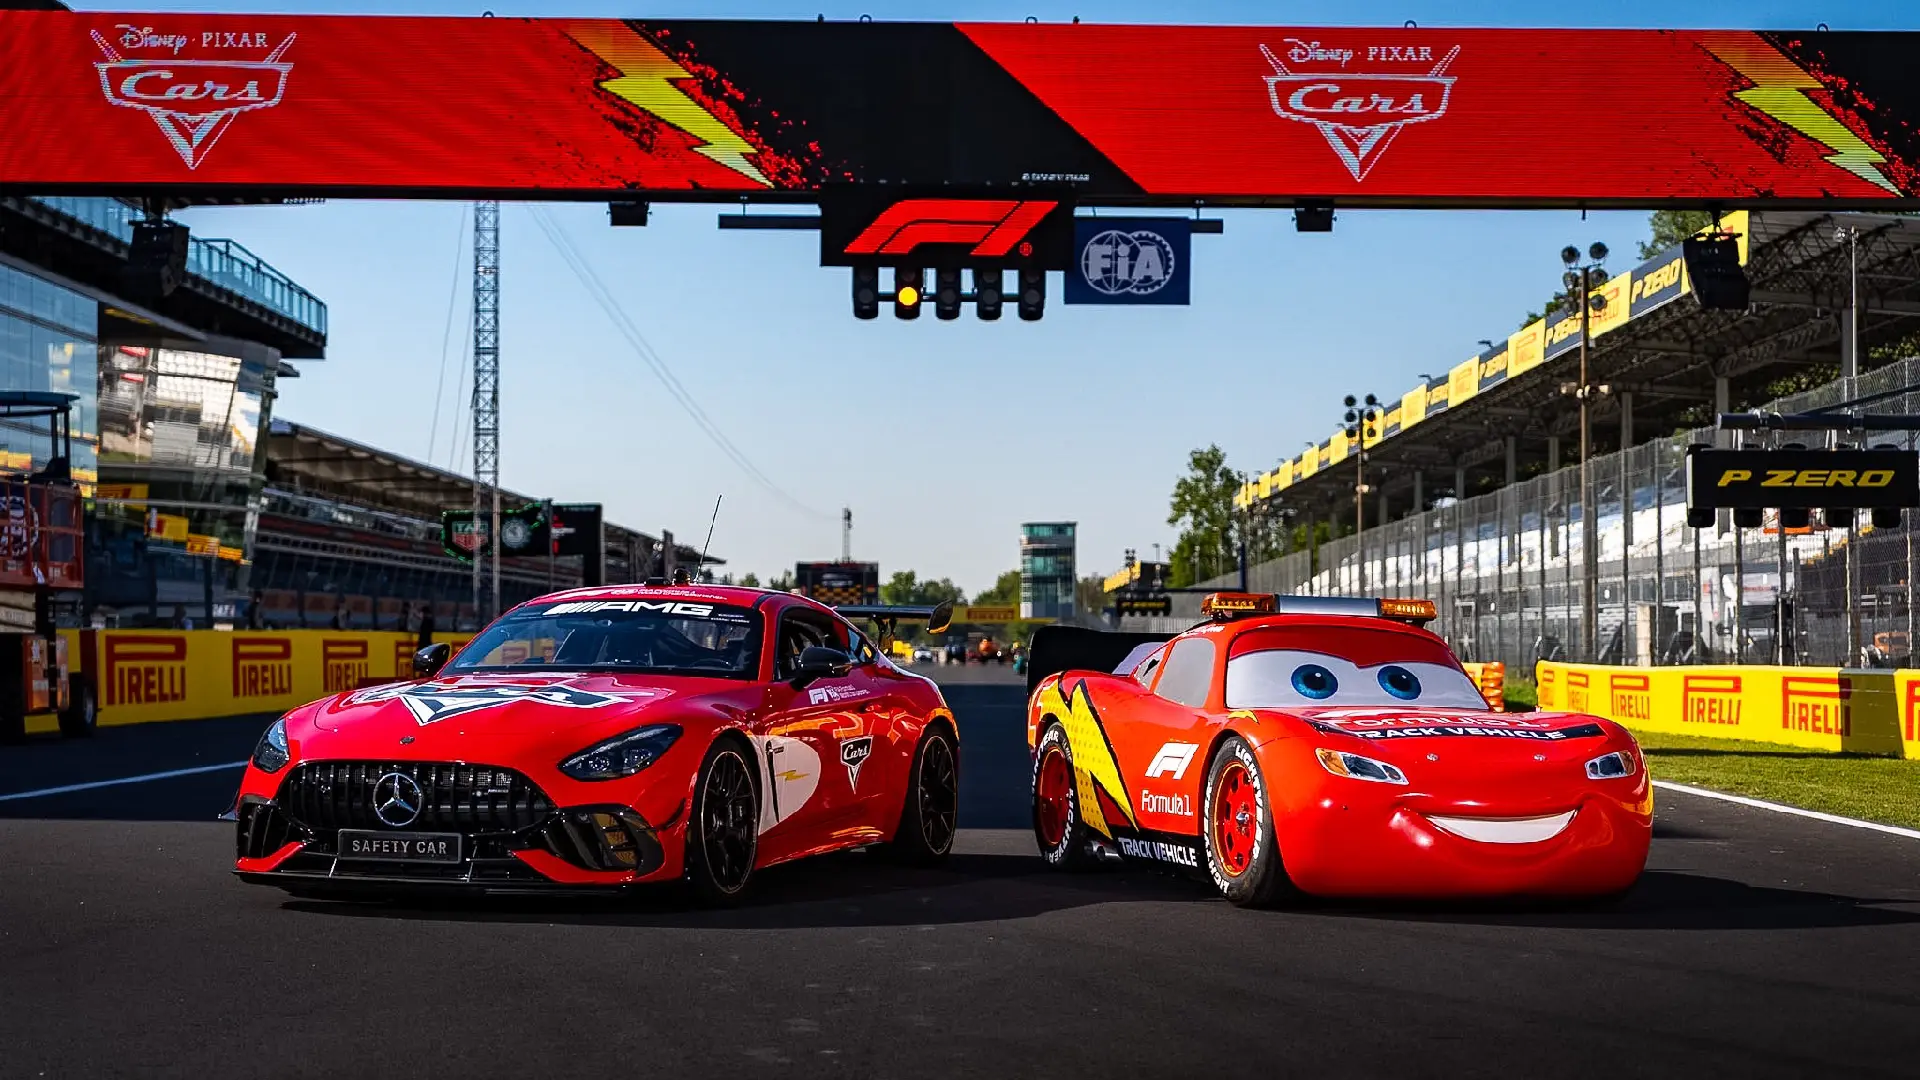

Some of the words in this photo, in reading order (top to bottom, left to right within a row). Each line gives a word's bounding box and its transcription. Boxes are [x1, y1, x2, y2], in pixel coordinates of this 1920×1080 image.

[202, 32, 269, 48] PIXAR
[1367, 46, 1434, 61] PIXAR
[120, 70, 265, 100] Cars
[1288, 83, 1430, 113] Cars
[1717, 469, 1752, 487] P
[1761, 469, 1895, 487] ZERO
[594, 601, 714, 617] AMG
[105, 635, 187, 706] PIRELLI
[232, 637, 291, 698] PIRELLI
[1610, 674, 1650, 720] PIRELLI
[1682, 675, 1742, 725] PIRELLI
[1782, 676, 1852, 737] PIRELLI
[1445, 727, 1567, 740] VEHICLE
[843, 744, 868, 760] Cars
[1235, 744, 1263, 860] LIGHTYEAR
[352, 840, 410, 853] SAFETY
[416, 841, 447, 854] CAR
[1118, 837, 1153, 859] TRACK
[1152, 841, 1198, 868] VEHICLE
